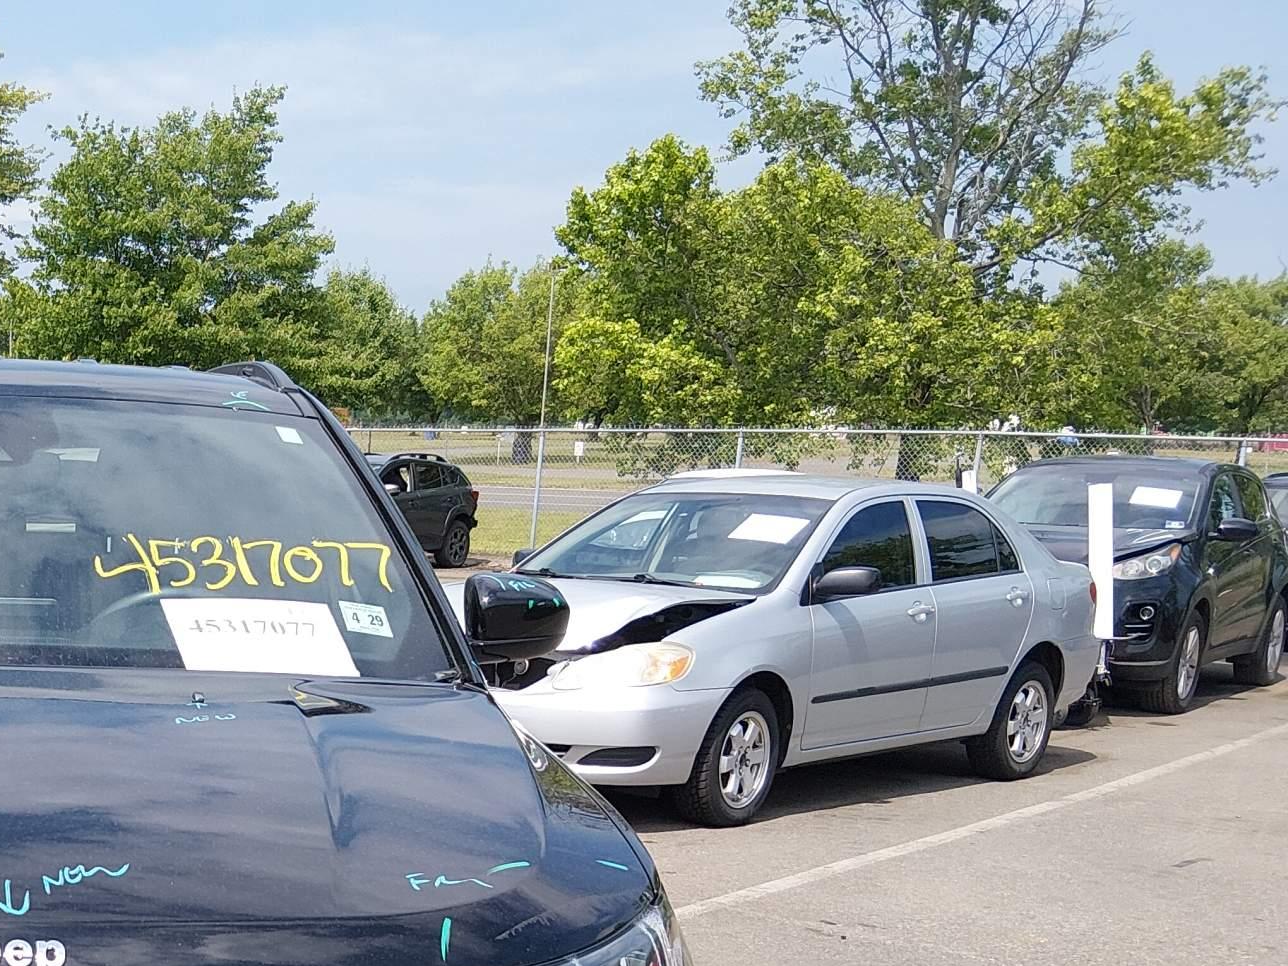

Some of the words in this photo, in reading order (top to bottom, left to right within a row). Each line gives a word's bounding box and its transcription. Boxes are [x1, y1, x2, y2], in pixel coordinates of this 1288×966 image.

[94, 533, 393, 594] 45317077
[352, 612, 361, 624] 4
[368, 614, 384, 627] 29
